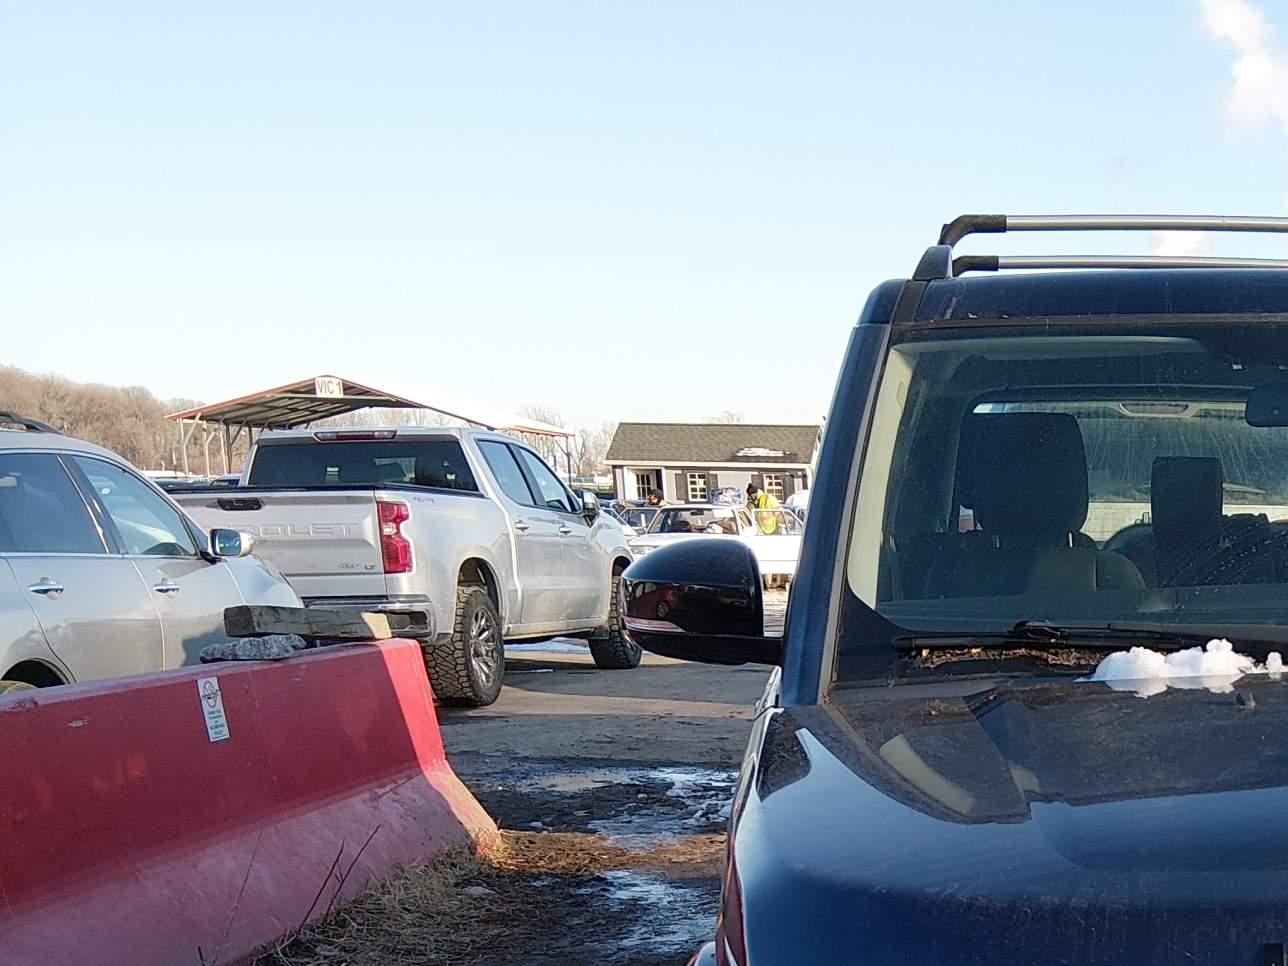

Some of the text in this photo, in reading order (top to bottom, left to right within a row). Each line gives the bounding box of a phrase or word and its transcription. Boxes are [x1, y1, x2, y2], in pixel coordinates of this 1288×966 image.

[317, 379, 342, 395] VIC 1
[230, 523, 360, 538] ROLET
